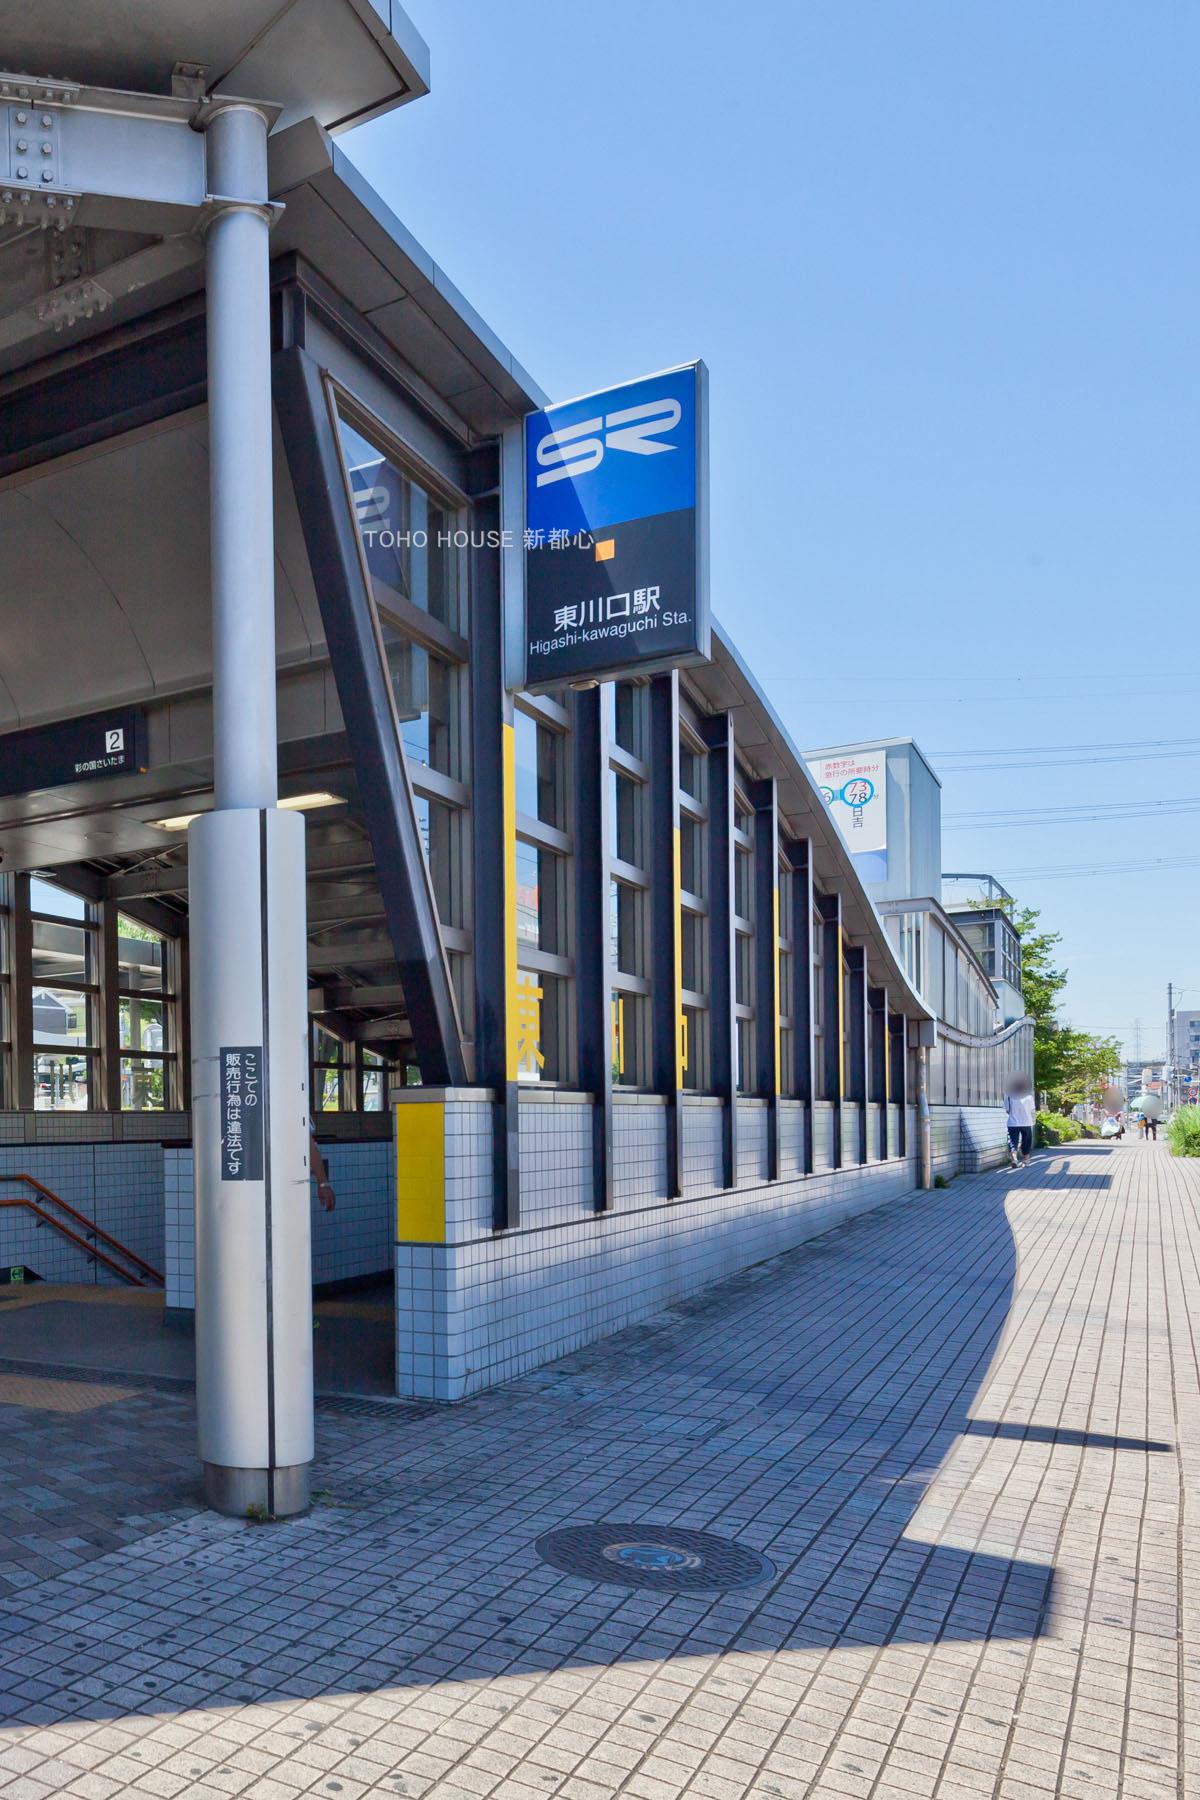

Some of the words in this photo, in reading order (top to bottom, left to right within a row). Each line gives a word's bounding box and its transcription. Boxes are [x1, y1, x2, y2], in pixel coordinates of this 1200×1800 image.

[536, 398, 682, 488] SR
[553, 585, 661, 632] 東川口駅
[529, 614, 658, 655] Higashi-kawaguchi
[662, 611, 692, 627] Sta.
[109, 731, 121, 750] 2
[74, 755, 125, 773] 彩の国さいたま
[849, 792, 867, 804] 78
[850, 781, 867, 793] 73
[244, 1053, 259, 1106] ここでの
[226, 1053, 242, 1175] 販売行為は違法です
